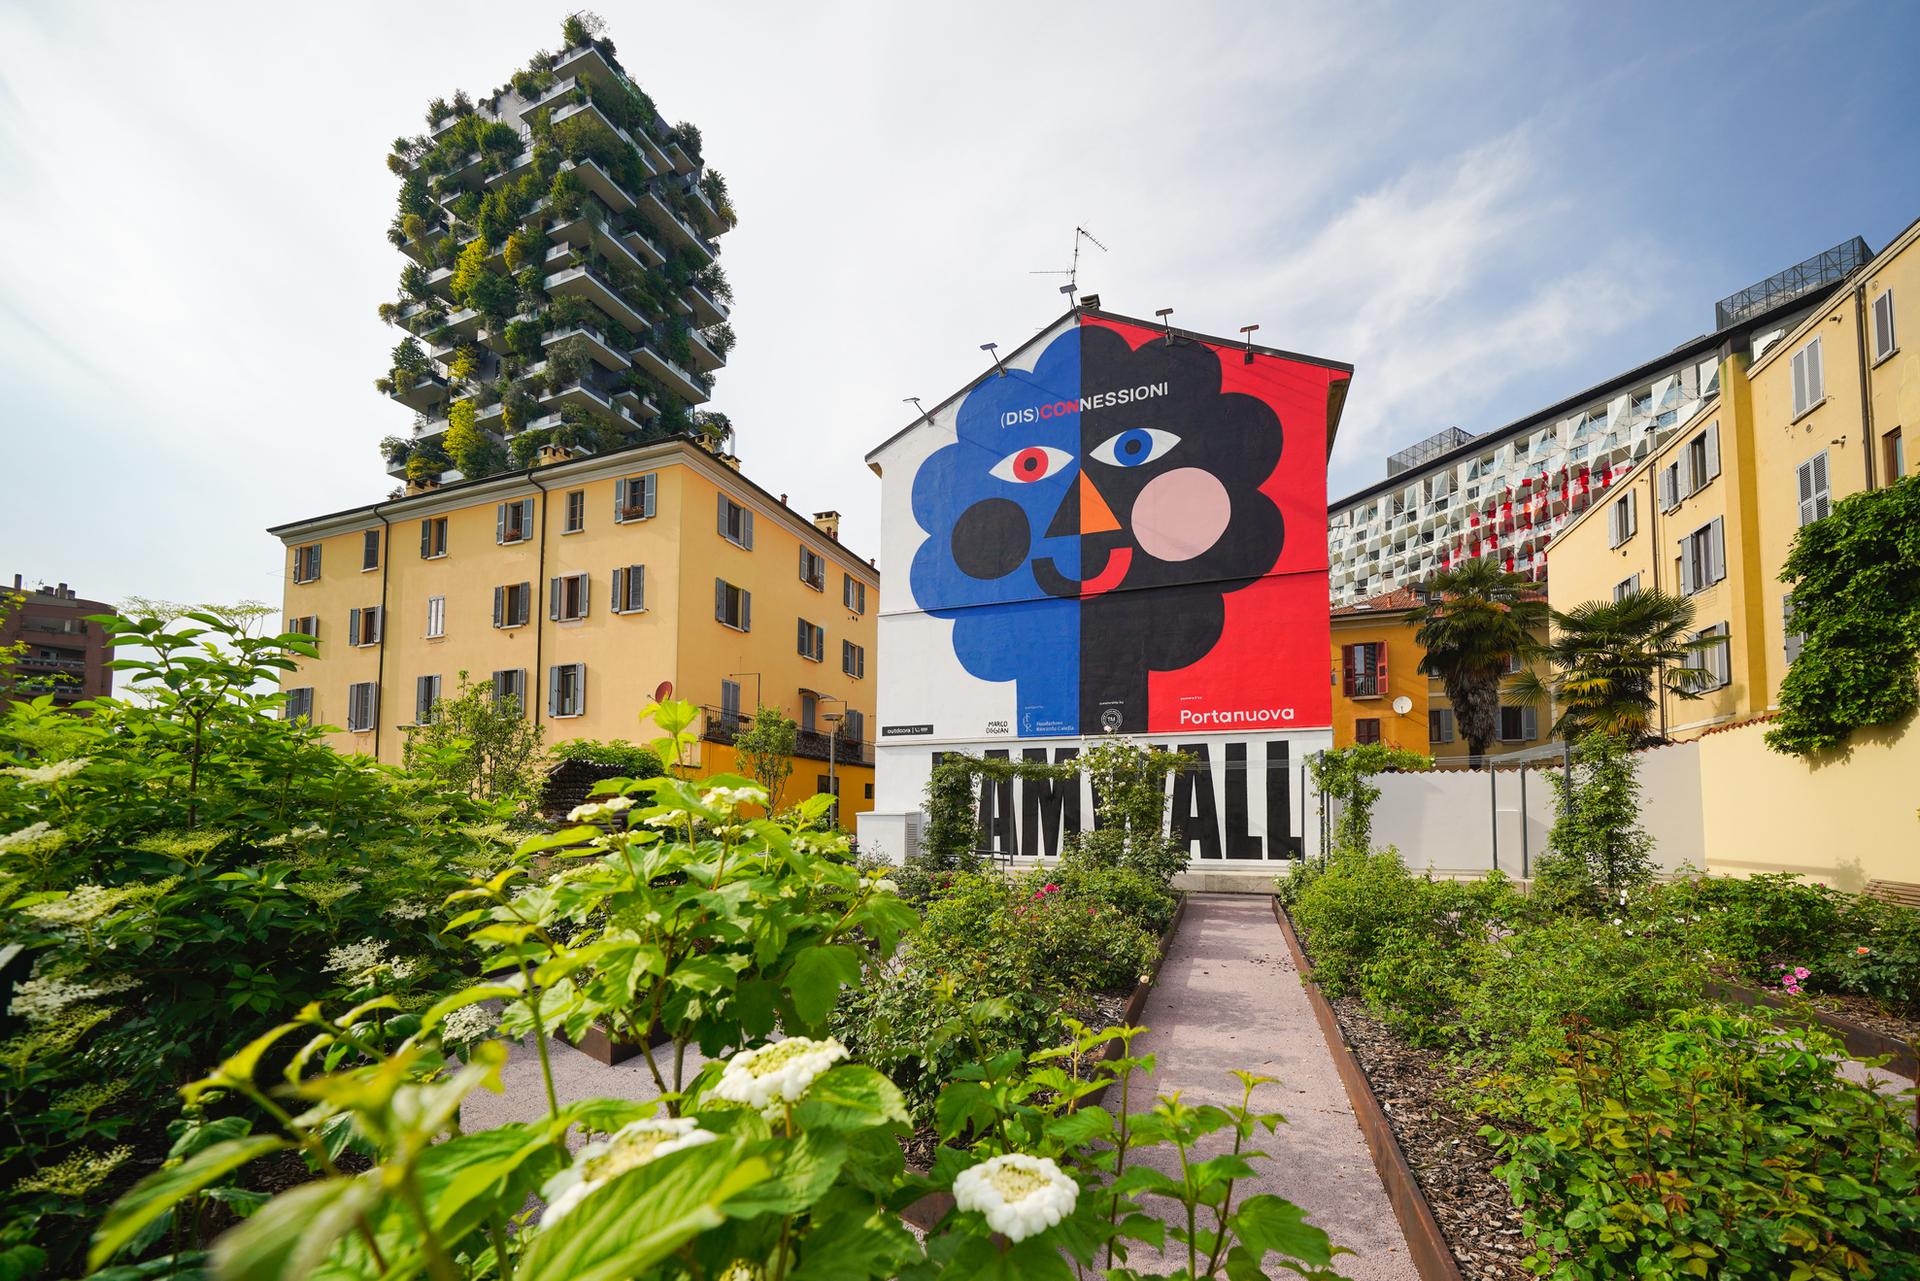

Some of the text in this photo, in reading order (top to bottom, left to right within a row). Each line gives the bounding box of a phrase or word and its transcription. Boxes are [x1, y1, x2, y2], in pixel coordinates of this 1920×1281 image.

[1001, 381, 1169, 429] (DIS)CONNESSIONI
[987, 720, 1008, 728] MARCO
[1180, 707, 1295, 725] Portanuova
